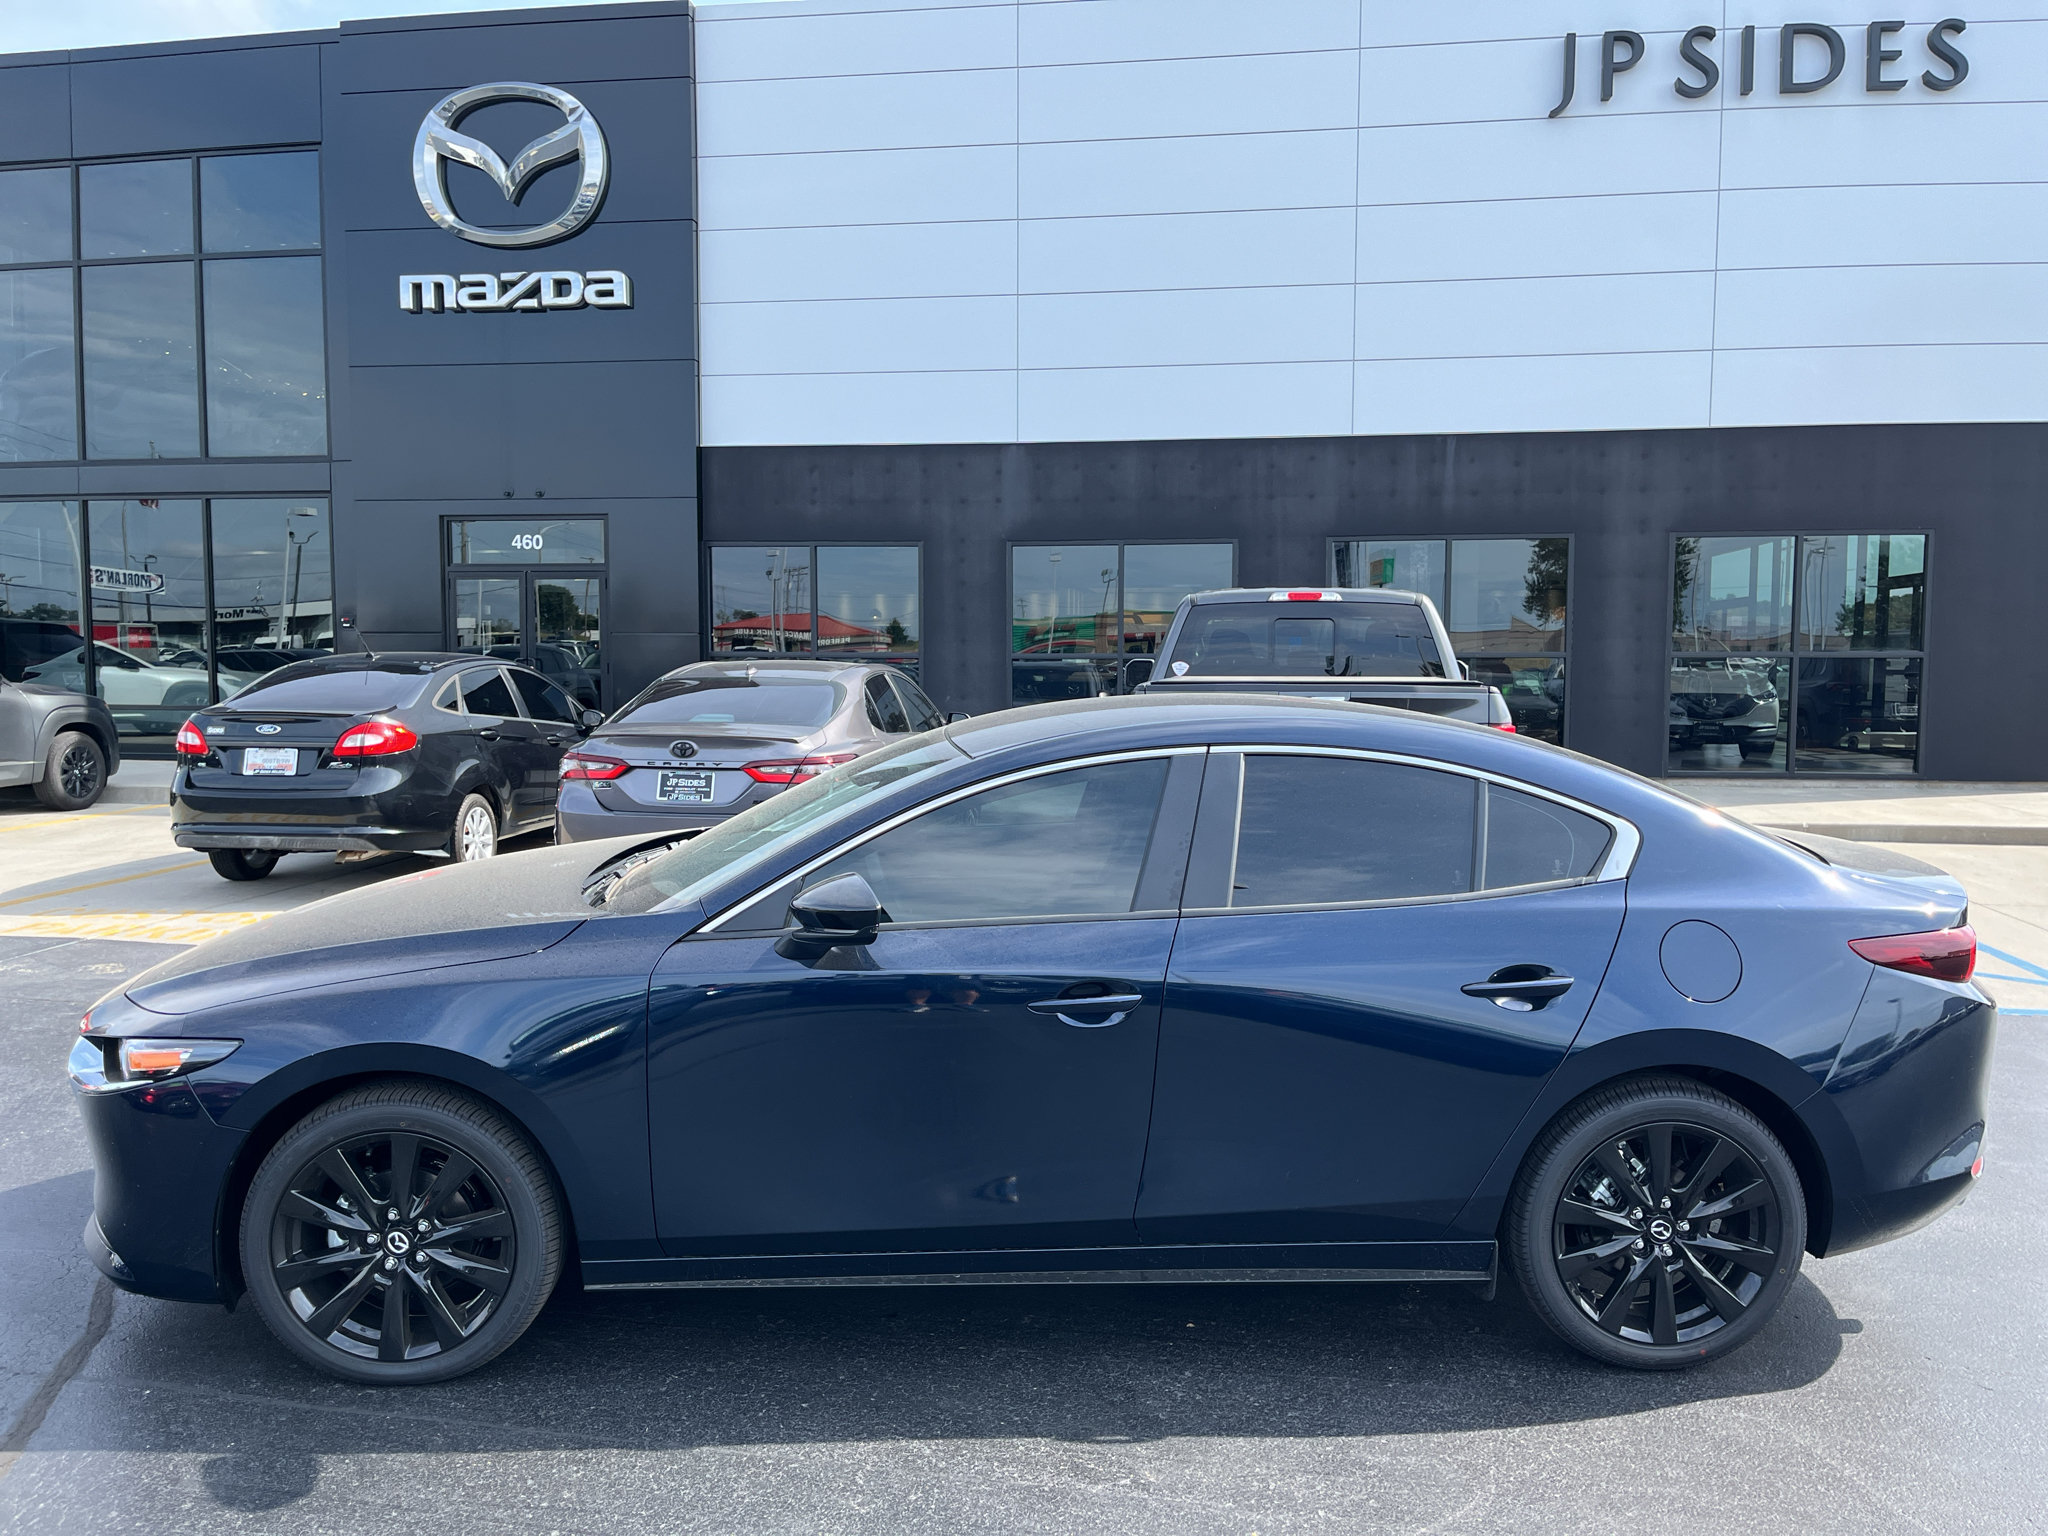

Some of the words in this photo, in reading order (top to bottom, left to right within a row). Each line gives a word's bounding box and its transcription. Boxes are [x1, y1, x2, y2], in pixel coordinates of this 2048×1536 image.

[1548, 30, 1645, 118] JP
[1674, 18, 1970, 98] SIDES
[511, 533, 544, 550] 460
[667, 778, 678, 786] JP
